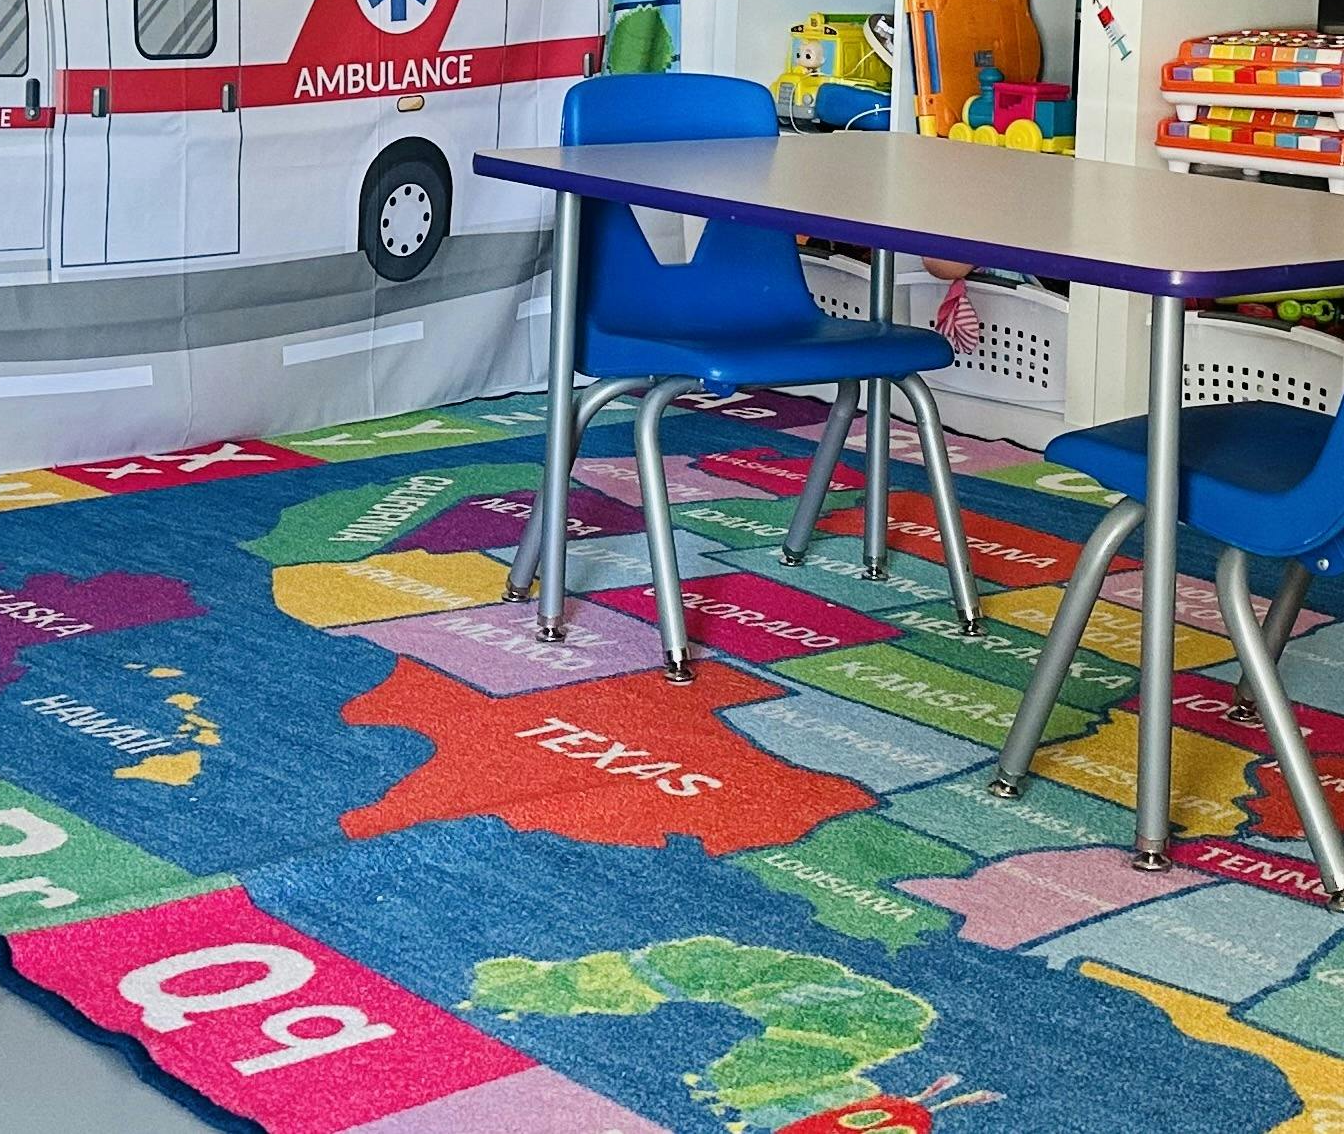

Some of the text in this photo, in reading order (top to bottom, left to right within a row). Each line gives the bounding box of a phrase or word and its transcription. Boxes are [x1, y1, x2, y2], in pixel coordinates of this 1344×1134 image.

[294, 53, 473, 99] AMBULANCE
[328, 475, 454, 543] CALIFORNIA
[679, 507, 789, 537] IDAHO
[21, 694, 173, 755] HAWAII
[514, 716, 723, 799] TEXAS
[762, 853, 919, 921] LOUISIANA
[118, 942, 398, 1078] Qq
